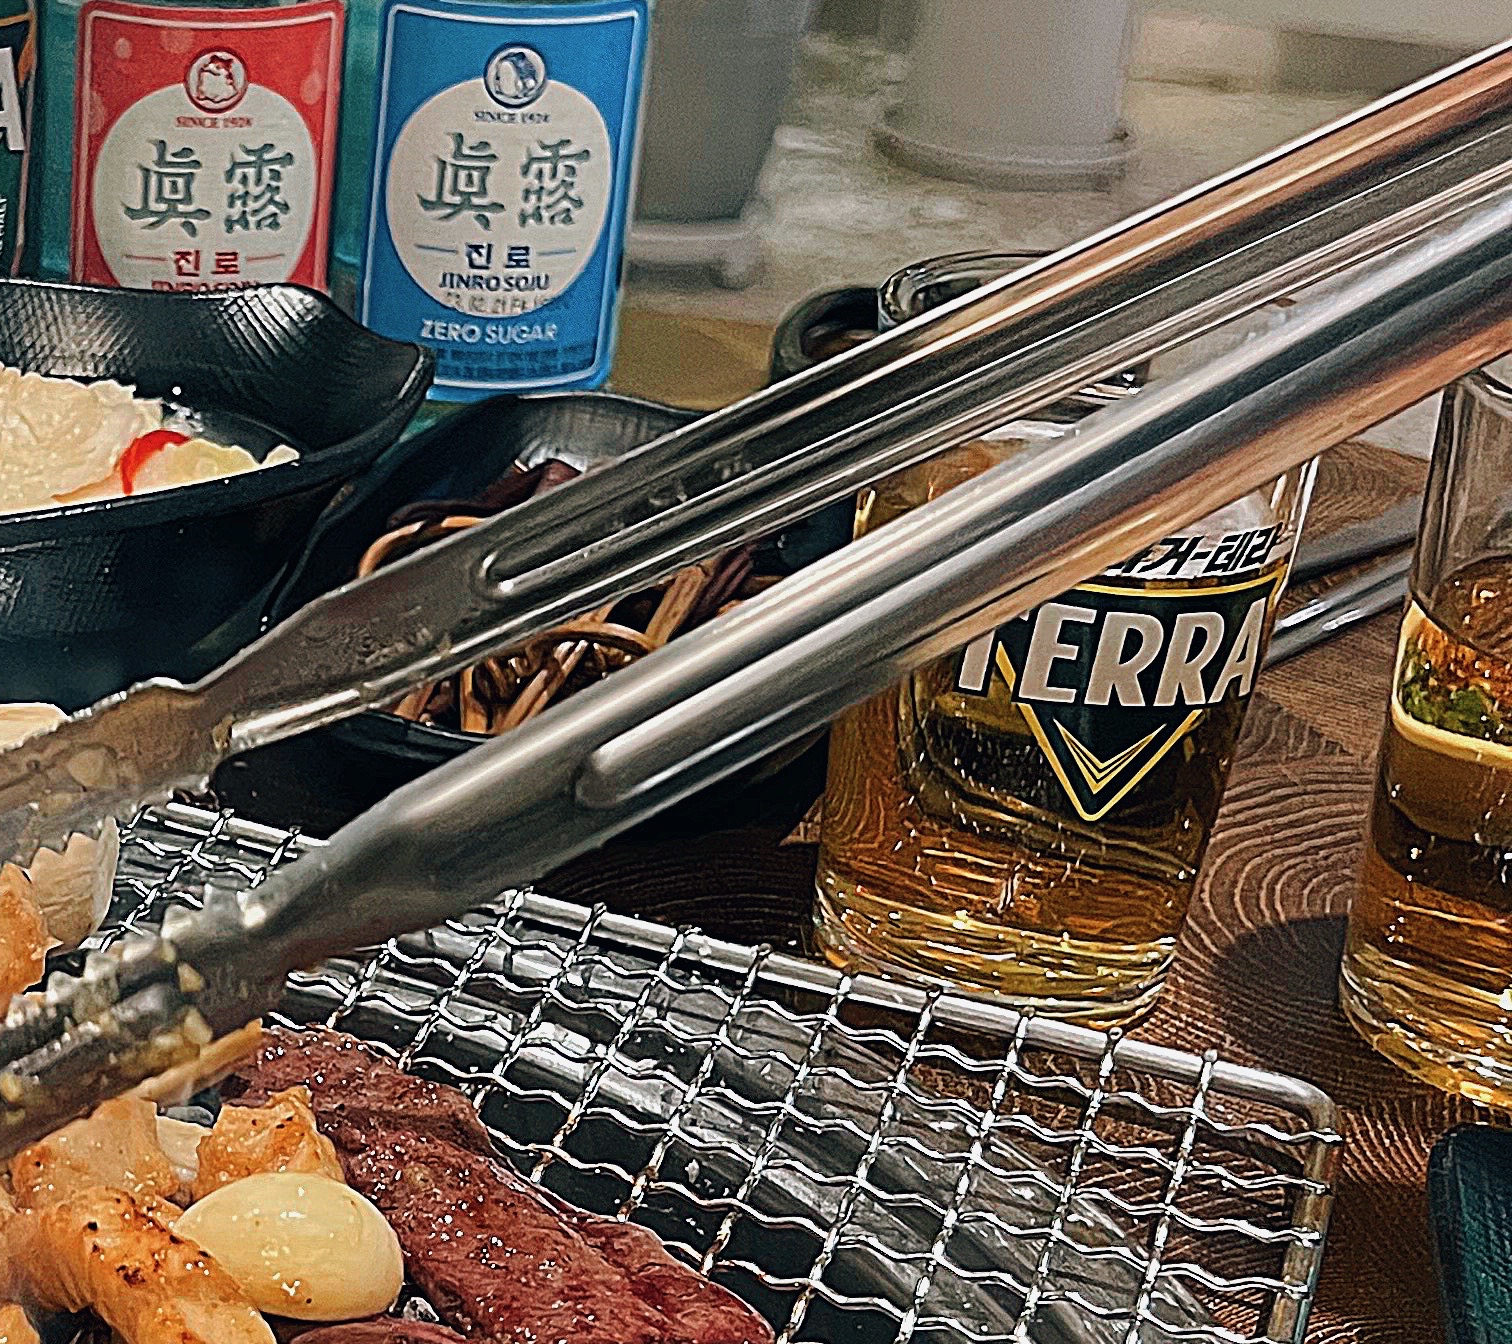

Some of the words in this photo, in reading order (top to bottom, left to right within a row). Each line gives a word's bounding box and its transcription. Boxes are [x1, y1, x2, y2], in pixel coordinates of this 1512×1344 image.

[176, 115, 220, 129] SINCE
[474, 110, 516, 124] SINCE
[439, 272, 499, 292] JINRO
[503, 273, 550, 292] SOJU
[420, 317, 481, 344] ZERO
[485, 322, 559, 345] SUGAR
[958, 597, 1267, 707] TERRA
